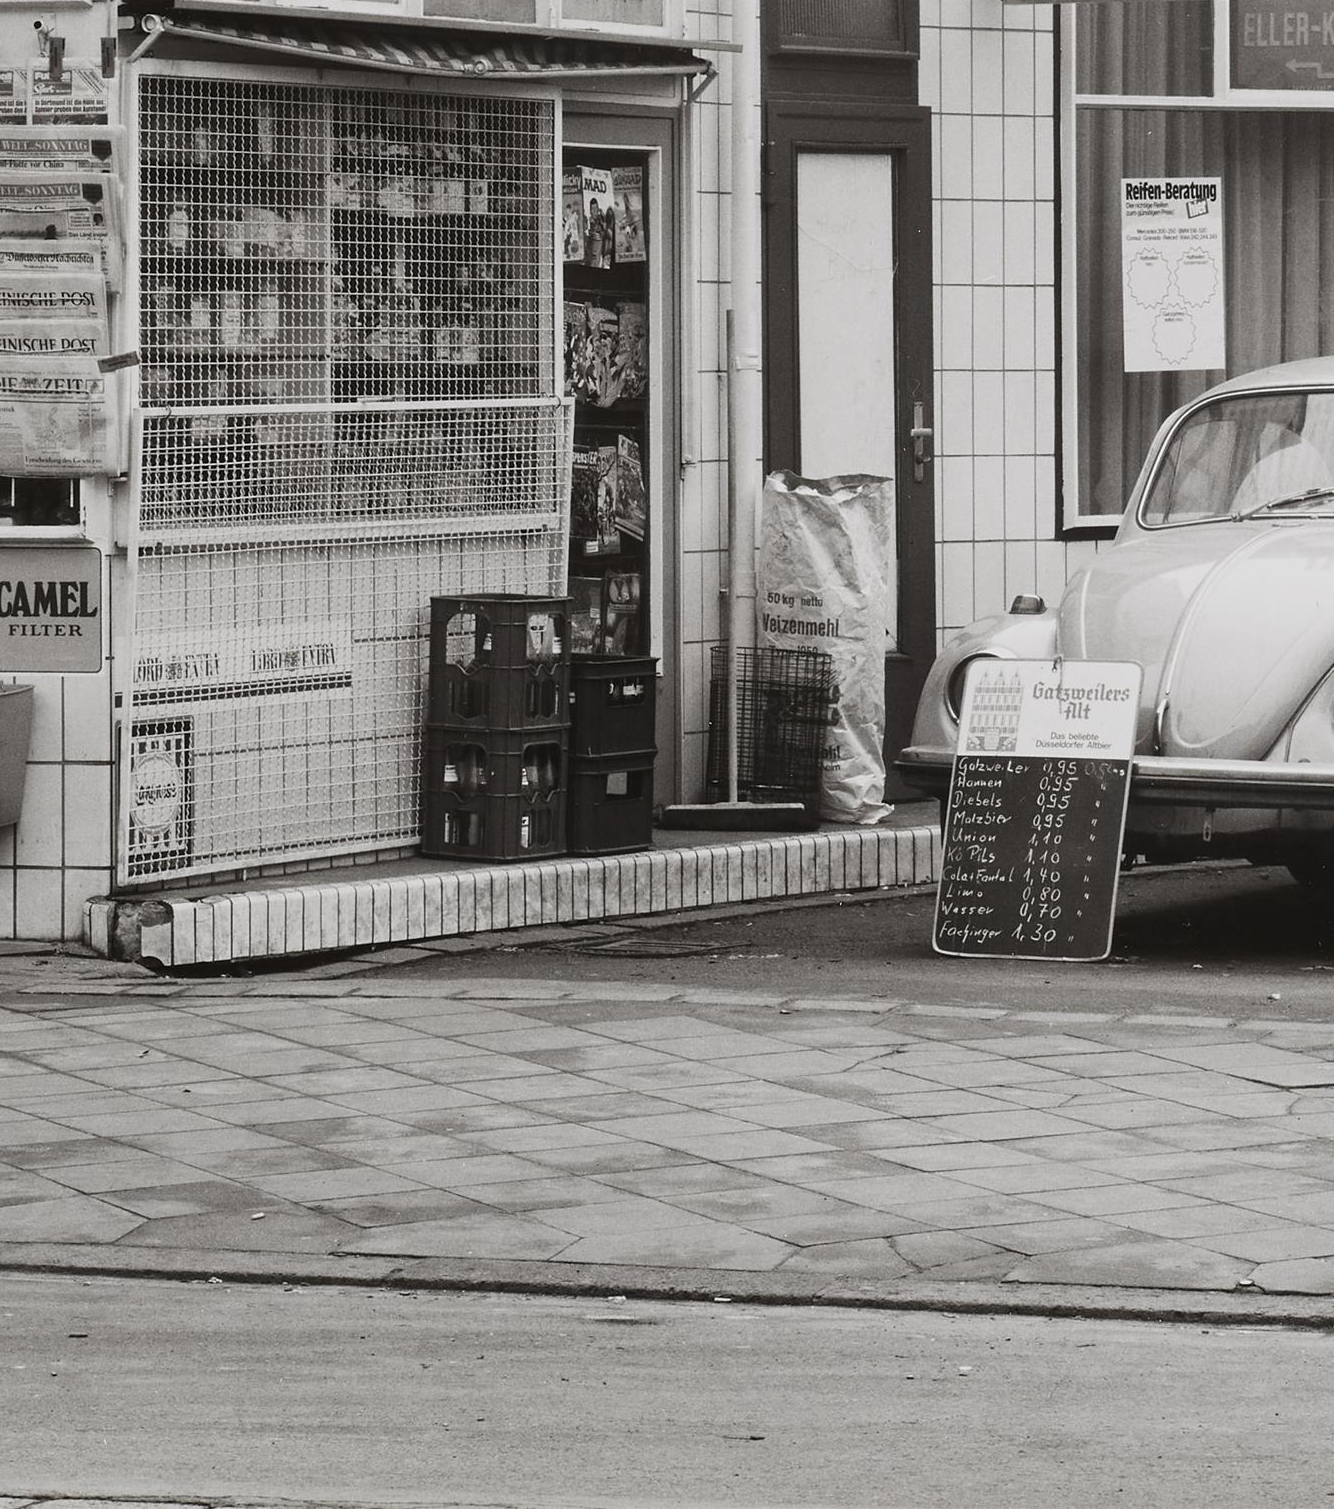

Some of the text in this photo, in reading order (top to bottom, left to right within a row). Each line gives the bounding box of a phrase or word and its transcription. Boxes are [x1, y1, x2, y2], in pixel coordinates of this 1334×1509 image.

[1, 140, 89, 151] WELT SONNTAG
[43, 159, 65, 168] China
[25, 184, 79, 196] SONNTAG
[583, 178, 607, 194] MAD
[1125, 181, 1217, 202] Reifen-Beratung
[61, 291, 96, 307] POST
[767, 592, 824, 608] 50 kg netto
[8, 623, 83, 637] FILTER
[184, 653, 219, 679] EXTRA
[252, 643, 337, 672] LORD EXTRA
[1032, 681, 1131, 702] Gatzweilers
[1064, 702, 1091, 720] Alt
[1035, 739, 1112, 750] Düsseldorfer Altbier
[1050, 731, 1100, 742] Das beliebte
[1042, 760, 1077, 778] 0,95
[957, 773, 1079, 792] Hannen 0,95
[952, 790, 1071, 812] Diebels 0,95
[953, 810, 1066, 831] Malzbier 0,95
[952, 827, 1062, 846] Union 1,10
[1023, 867, 1061, 886] 1,40
[946, 886, 1061, 905] Limo 0,80
[941, 901, 1062, 922] Wasser 0,70
[1011, 922, 1057, 942] 1,30
